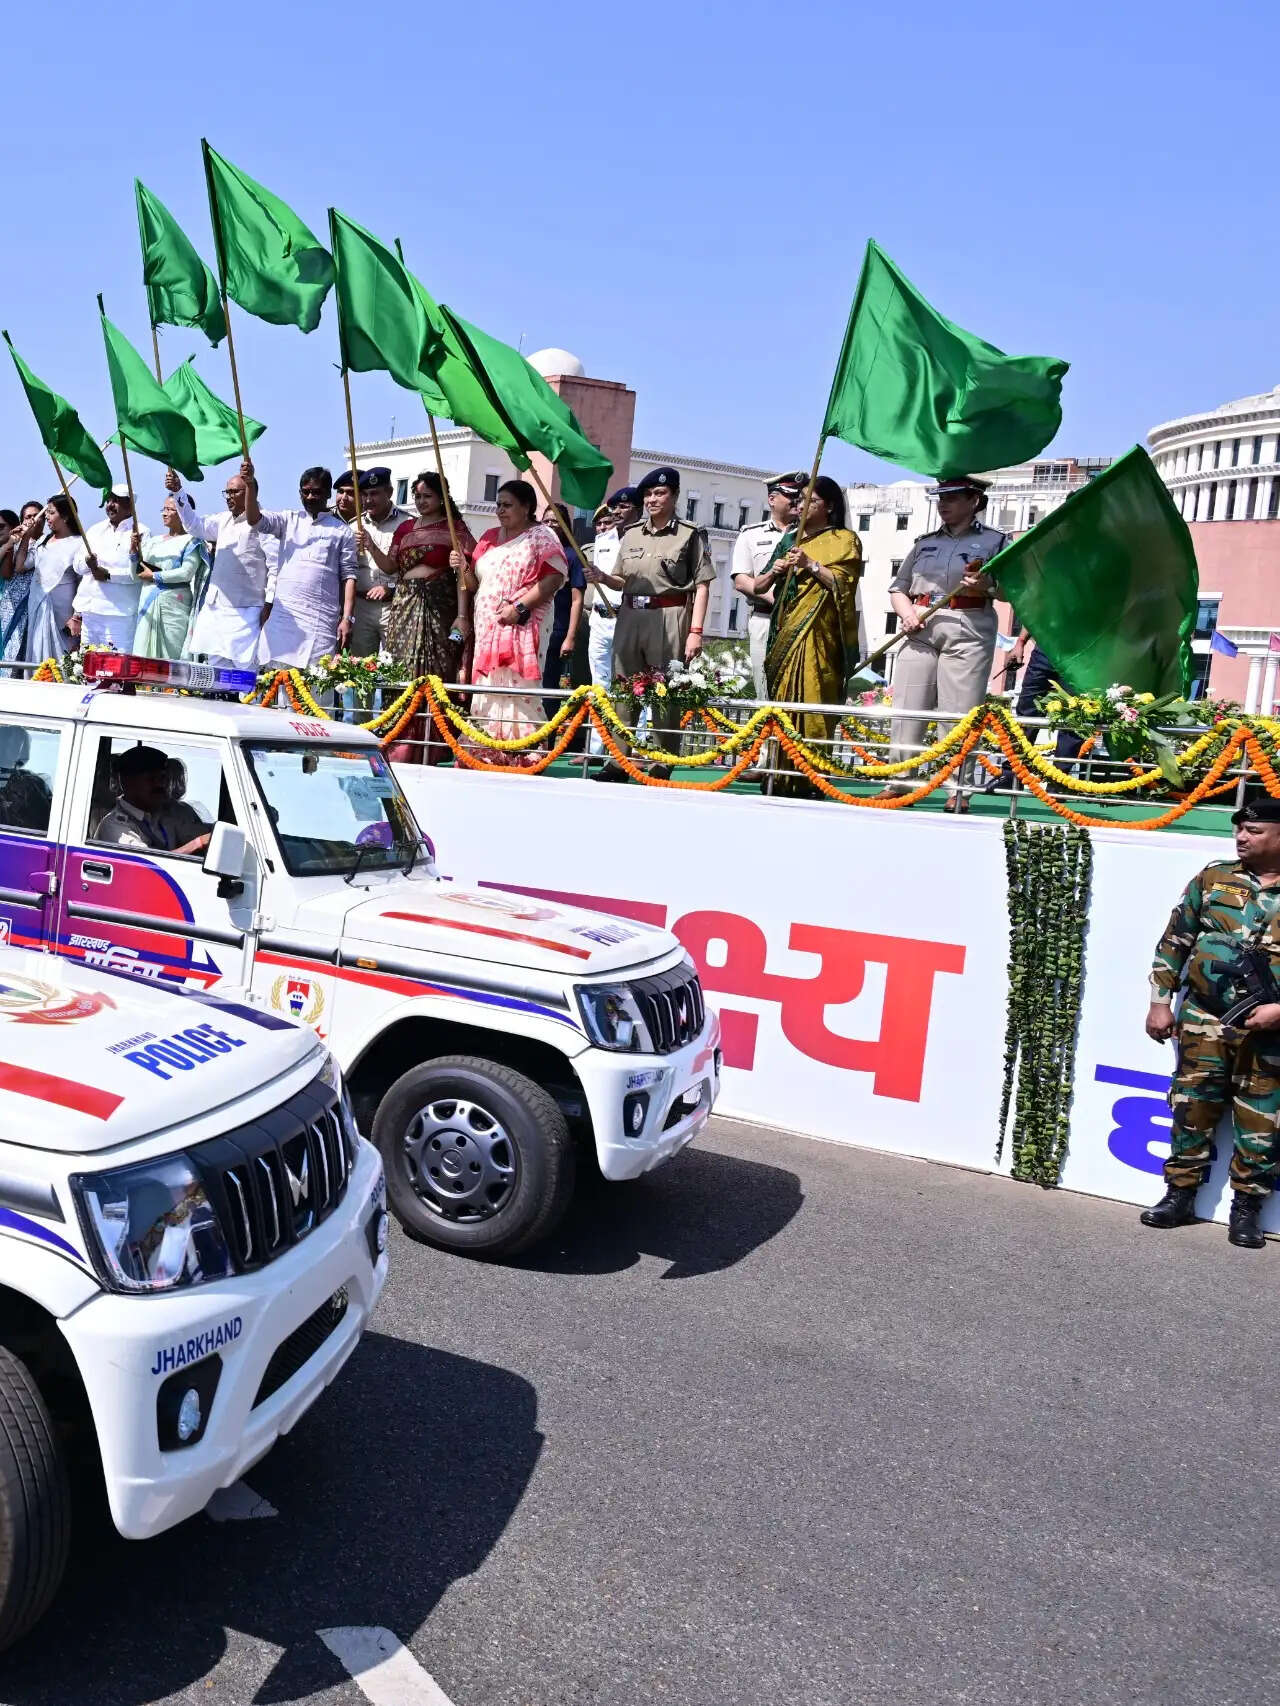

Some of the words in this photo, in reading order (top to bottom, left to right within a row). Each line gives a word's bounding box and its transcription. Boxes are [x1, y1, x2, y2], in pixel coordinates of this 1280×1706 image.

[288, 721, 331, 737] POLICE
[68, 933, 112, 952] झारखण्ड
[105, 1031, 158, 1054] JHARKHAND
[123, 1023, 247, 1080] POLICE
[151, 1316, 242, 1375] JHARKHAND
